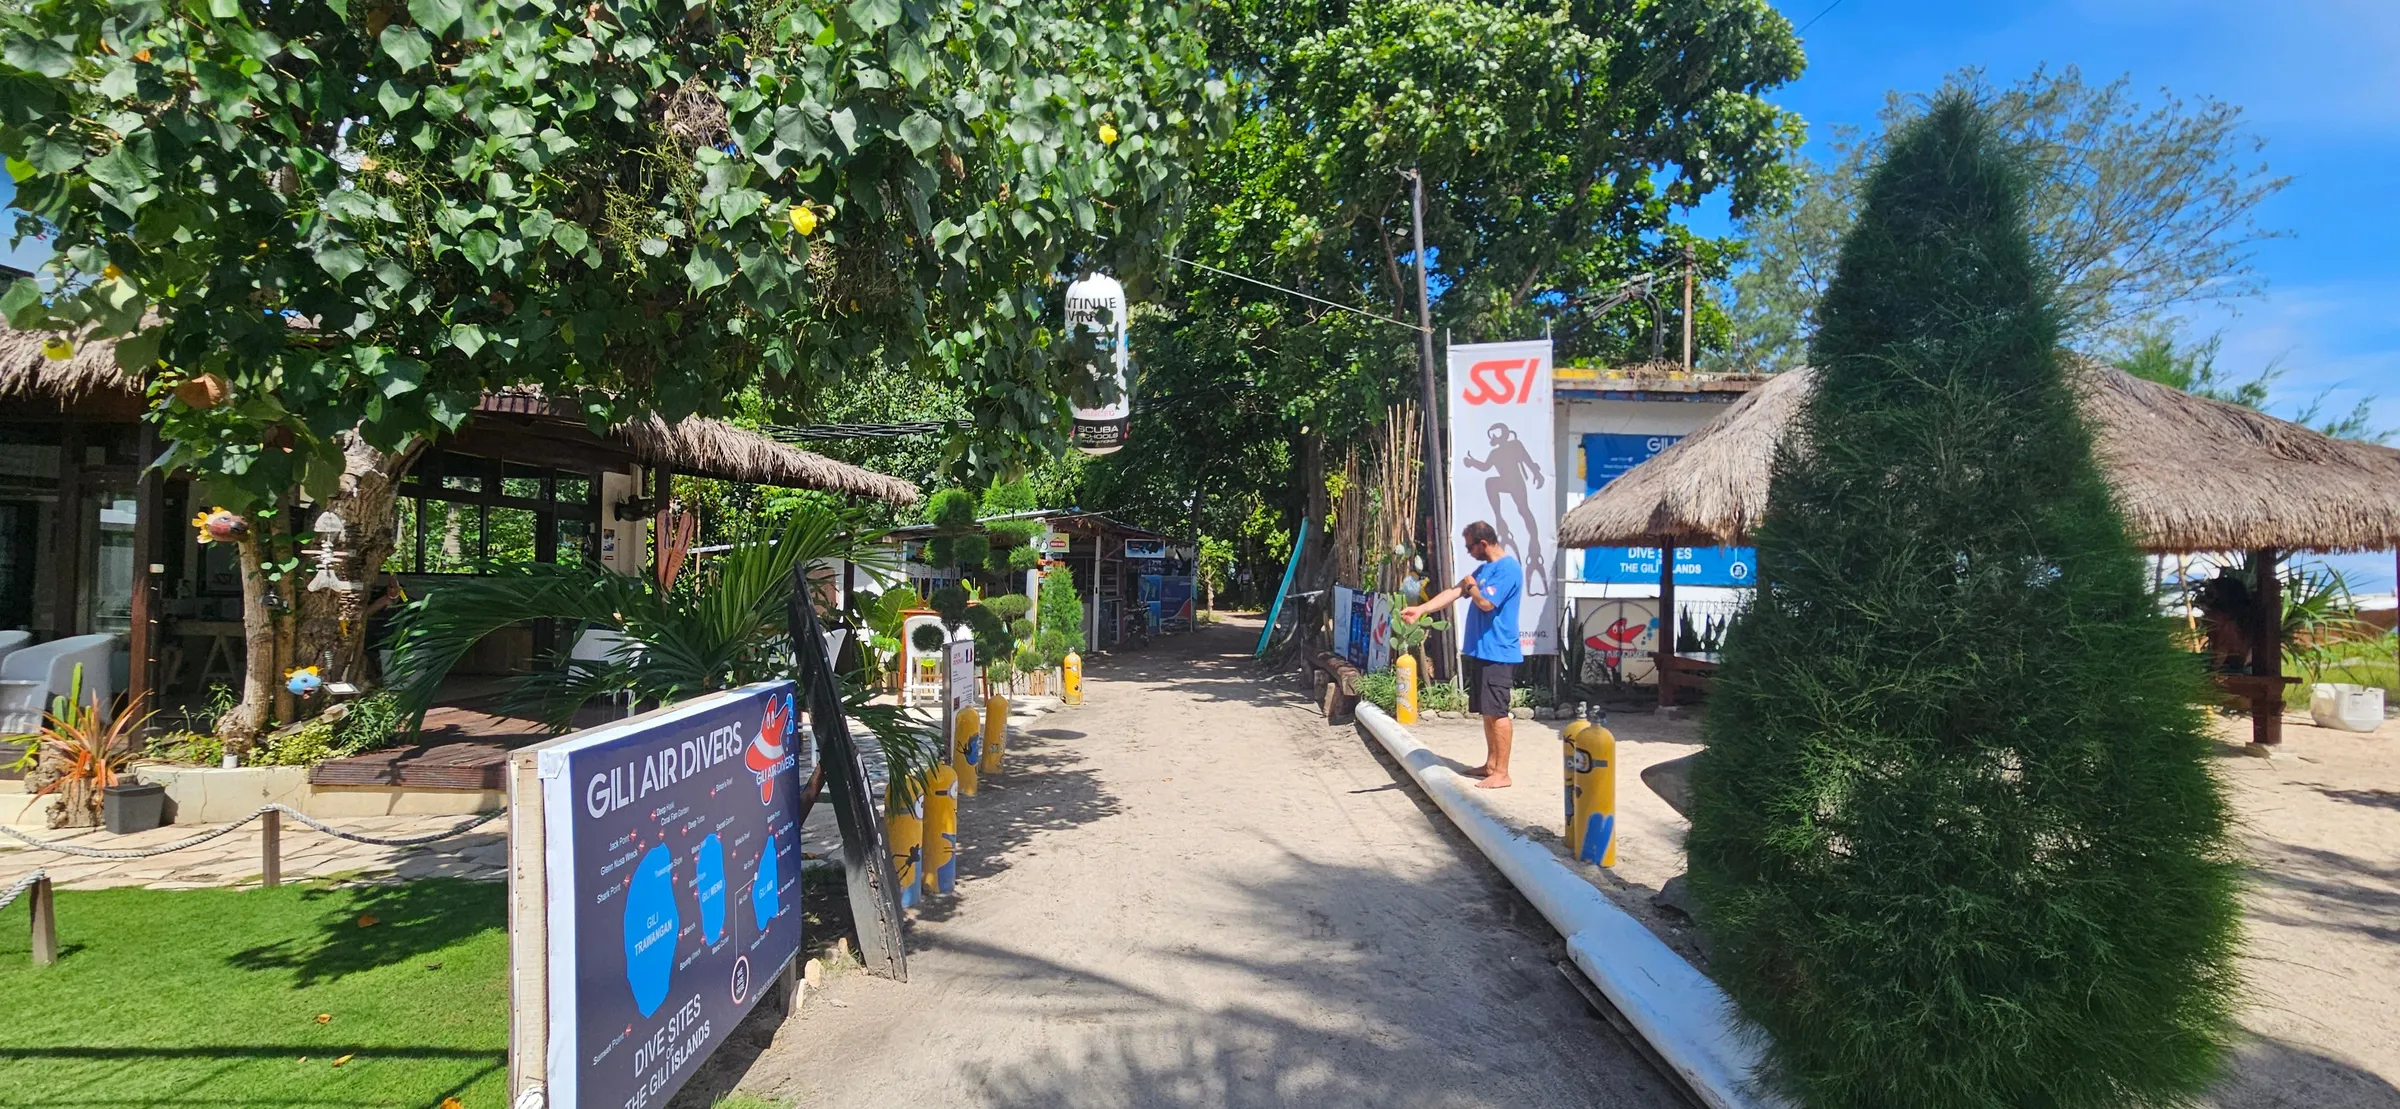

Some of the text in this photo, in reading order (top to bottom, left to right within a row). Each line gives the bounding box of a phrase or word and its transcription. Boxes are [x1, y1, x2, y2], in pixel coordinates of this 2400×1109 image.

[1462, 358, 1541, 406] SSI
[1077, 425, 1119, 434] SCUBA
[1628, 547, 1656, 559] DIVE
[1620, 563, 1639, 573] THE
[1640, 563, 1659, 573] GILI
[587, 721, 743, 819] GILI AIR DIVERS
[777, 753, 795, 776] DIVERS
[608, 834, 630, 851] Jack Point
[600, 849, 638, 876] Glenn Nusa Wreck
[597, 883, 621, 904] Shark Point
[646, 911, 659, 929] GILI
[634, 918, 673, 957] TRAWANGAN
[634, 993, 701, 1078] DIVE SITES
[592, 1032, 625, 1066] Sunset Point
[649, 1061, 669, 1096] GILI
[671, 1019, 710, 1075] ISLANDS
[665, 1043, 674, 1060] OF
